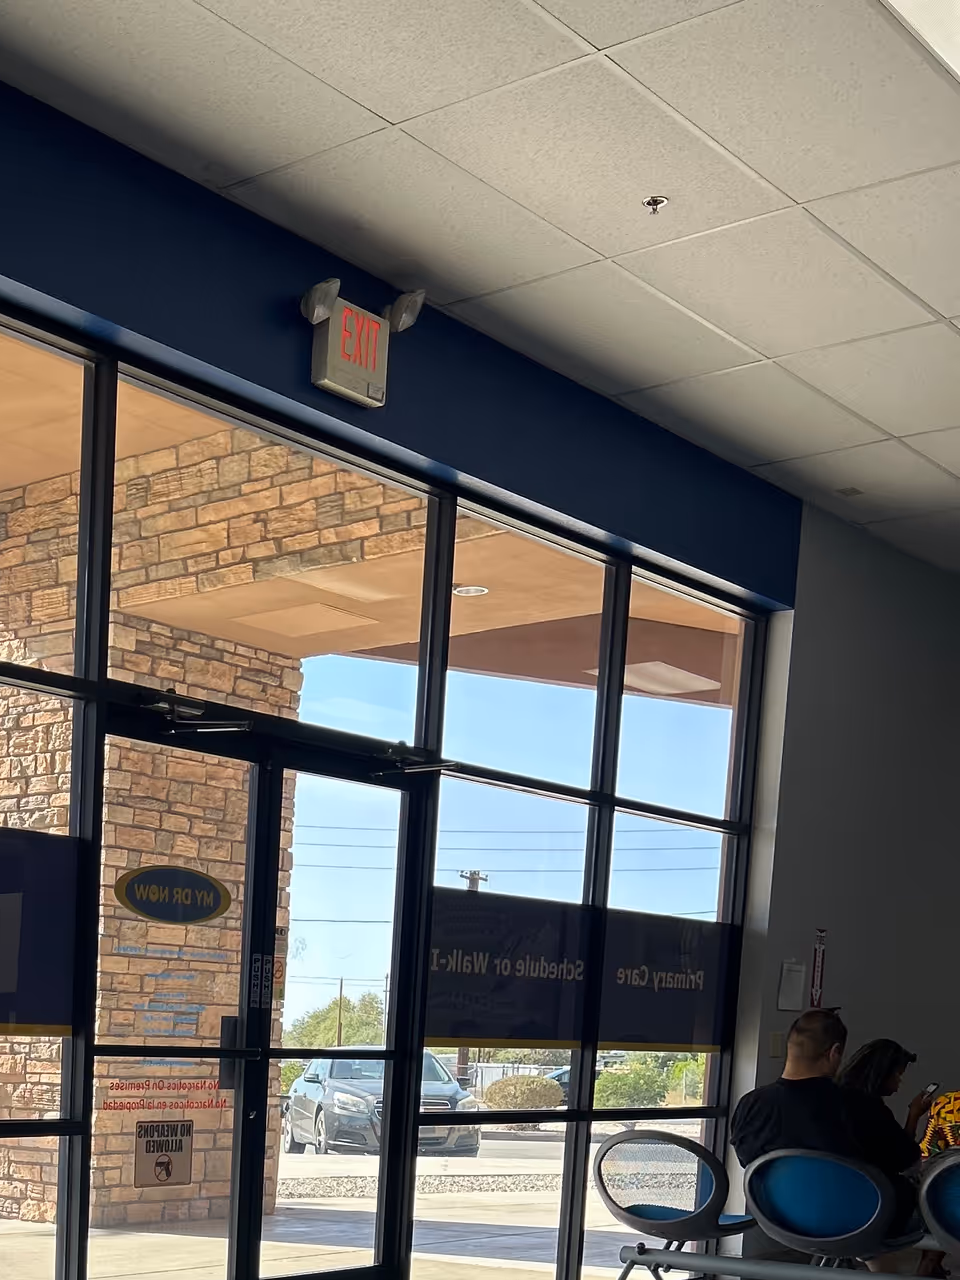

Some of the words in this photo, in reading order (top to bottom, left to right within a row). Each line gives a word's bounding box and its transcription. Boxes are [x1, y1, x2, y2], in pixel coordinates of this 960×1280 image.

[341, 306, 381, 372] EXIT
[252, 957, 261, 989] PUSH
[263, 958, 271, 991] PUSH
